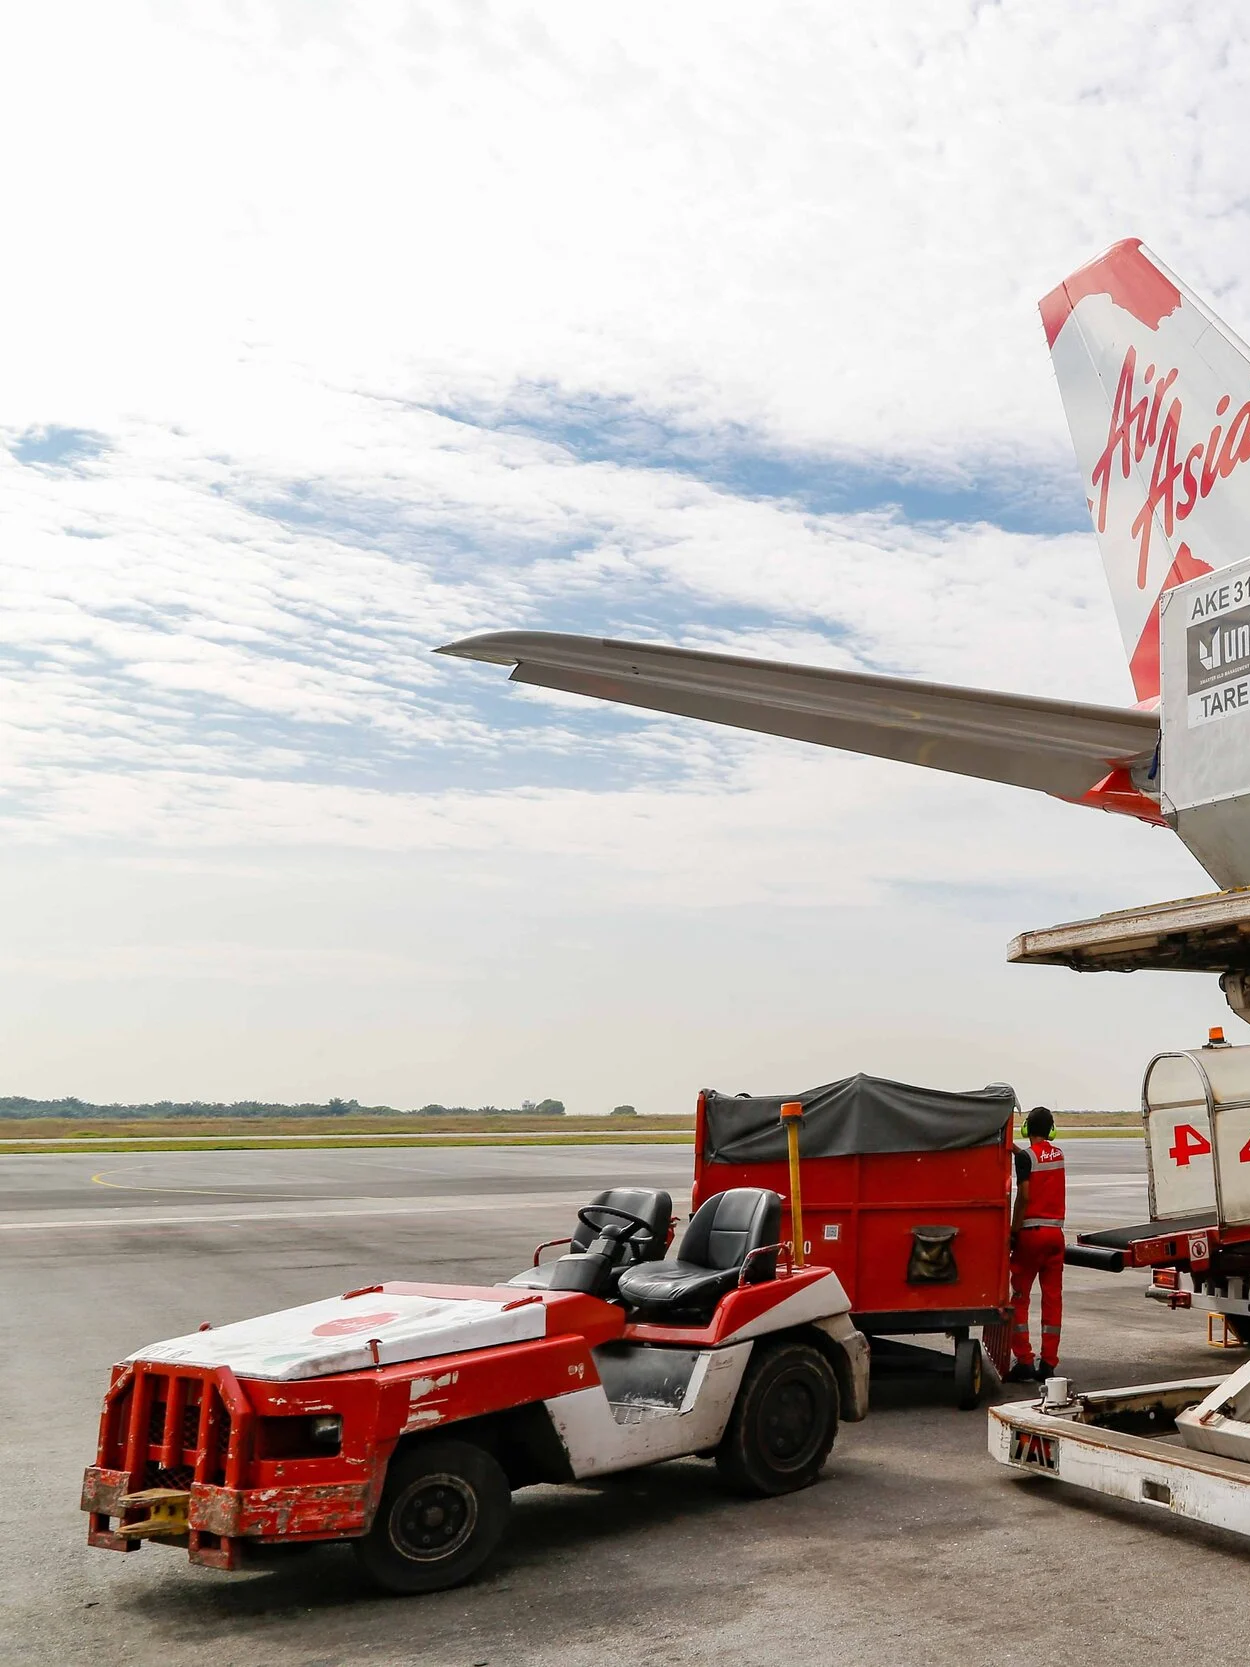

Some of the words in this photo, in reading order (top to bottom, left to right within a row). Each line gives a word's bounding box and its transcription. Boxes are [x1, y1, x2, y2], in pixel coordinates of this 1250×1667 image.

[1092, 345, 1178, 533] Air
[1192, 585, 1230, 620] AKE
[1201, 682, 1249, 718] TARE
